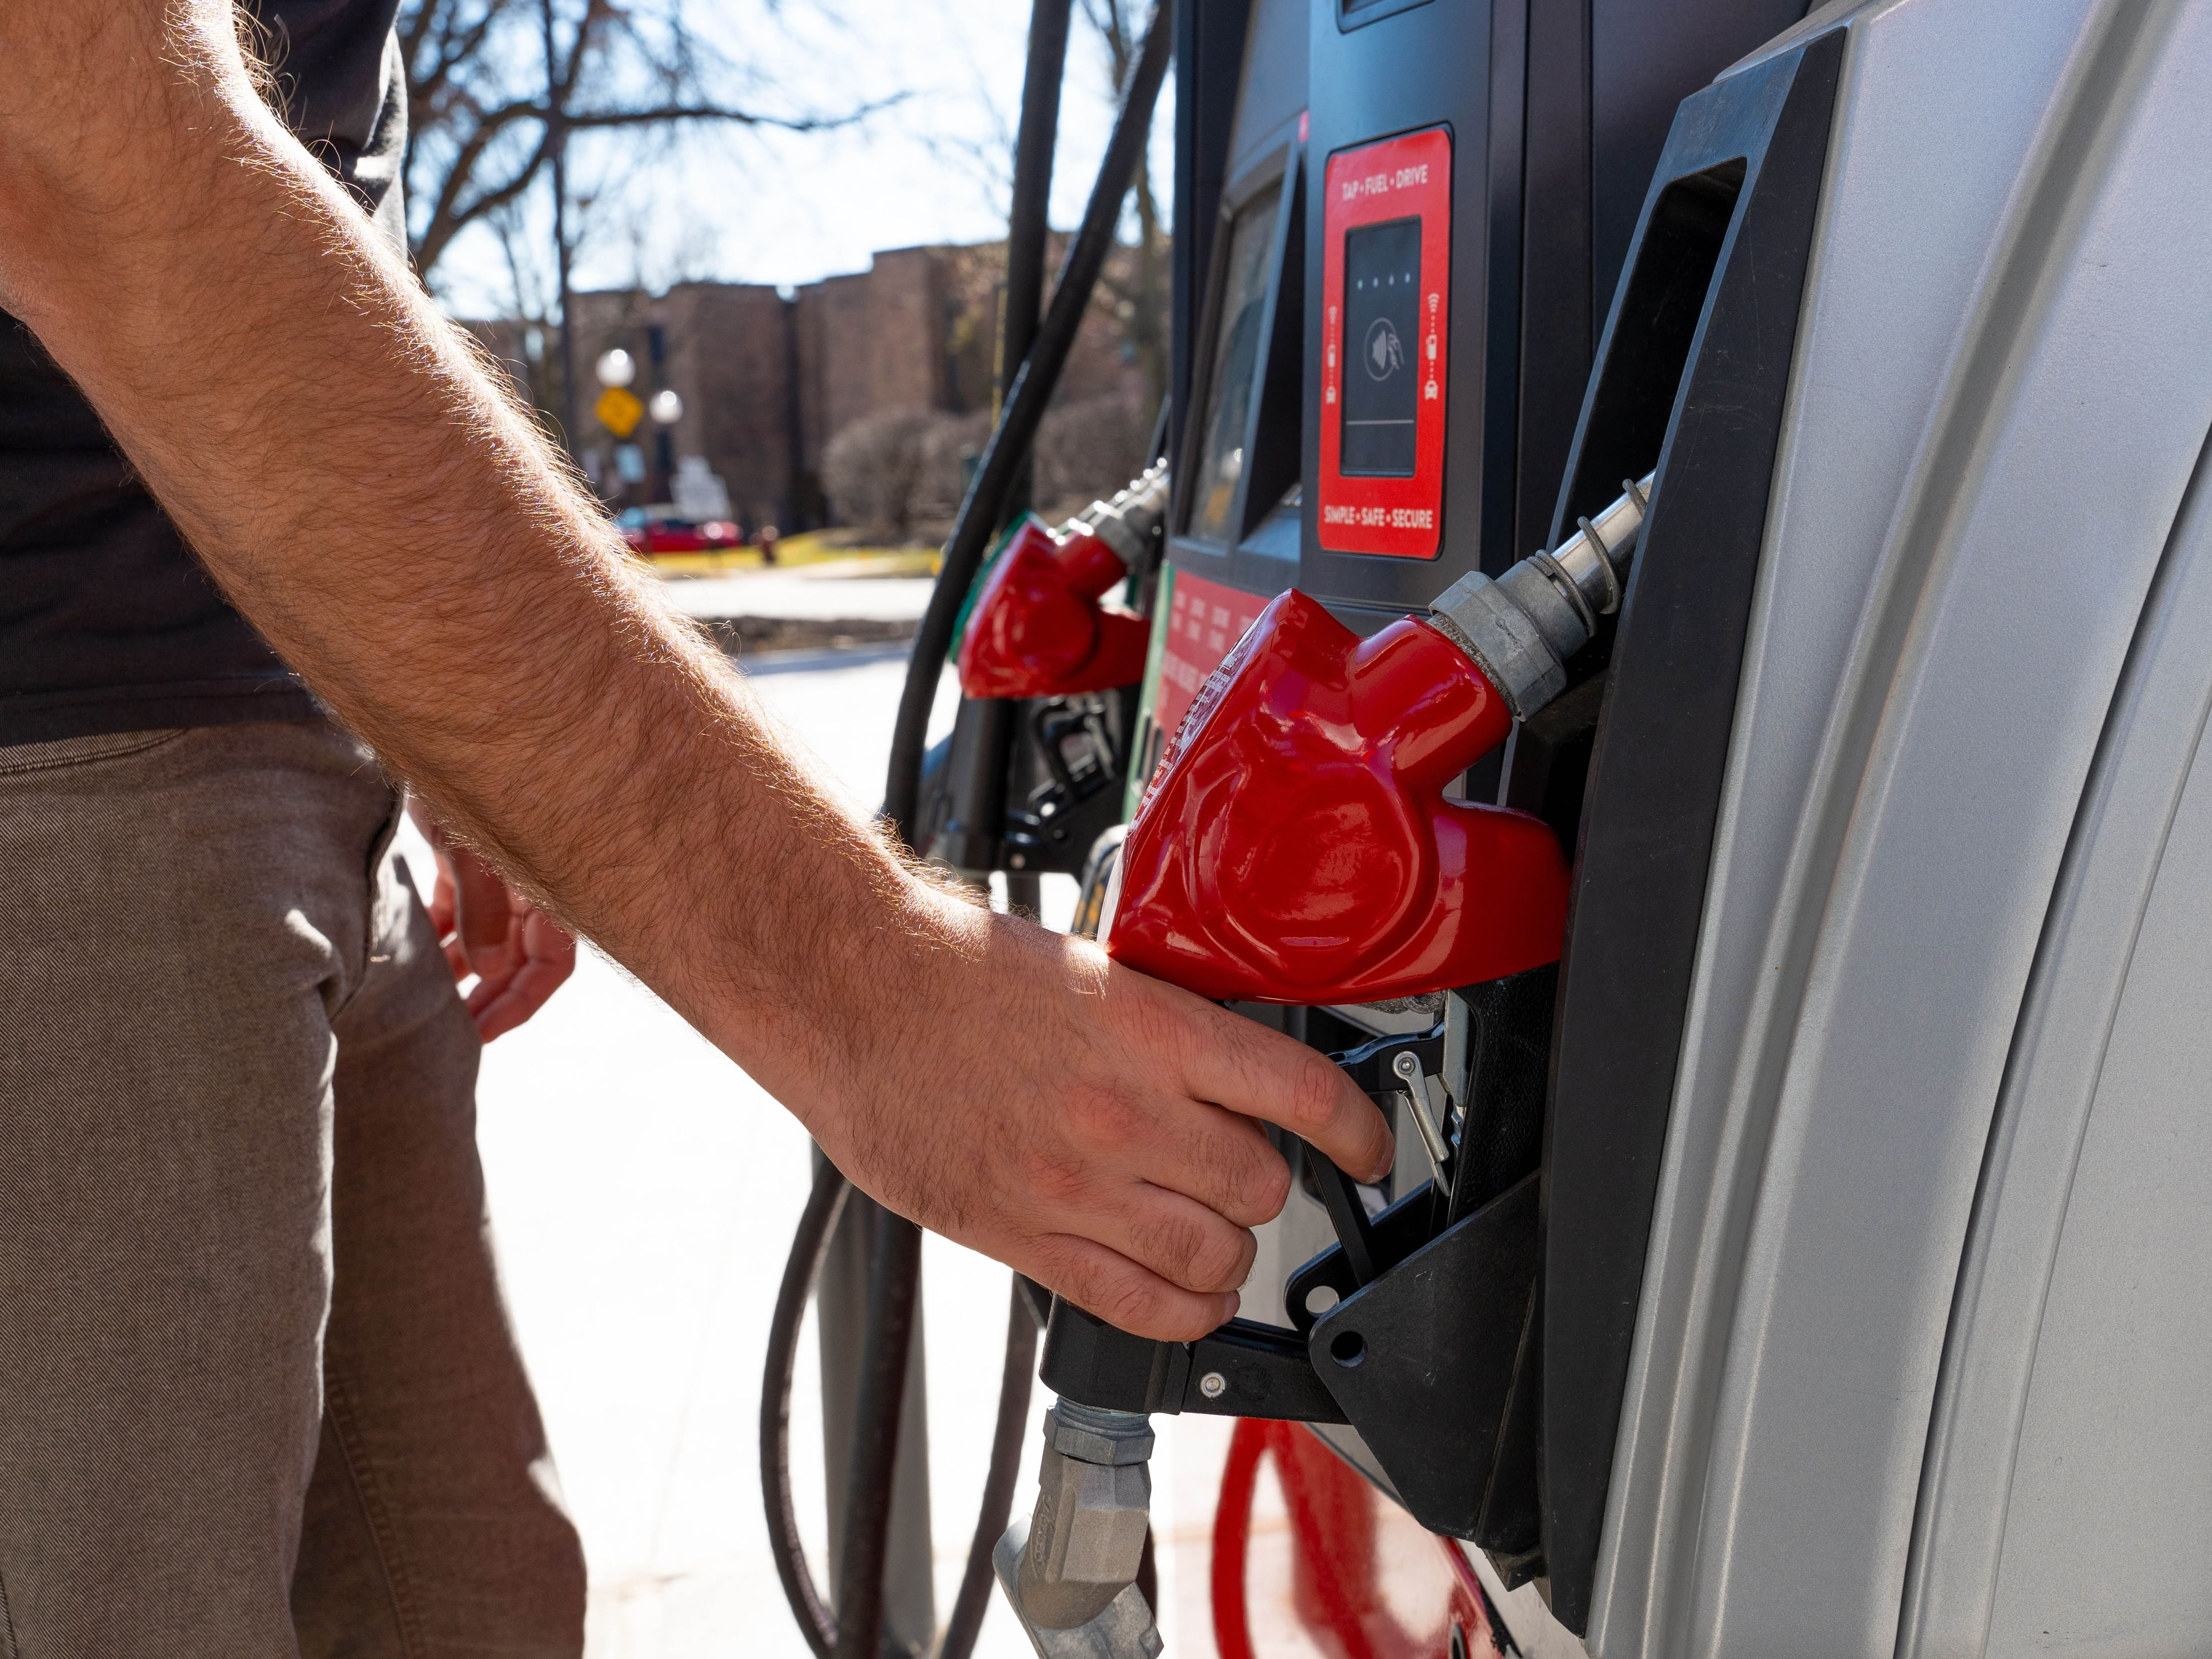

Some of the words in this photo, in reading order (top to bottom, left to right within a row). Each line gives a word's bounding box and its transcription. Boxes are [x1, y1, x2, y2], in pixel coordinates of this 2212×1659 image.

[1342, 180, 1359, 200] TAP
[1364, 174, 1389, 196] FUEL
[1396, 164, 1428, 189] DRIVE
[1324, 505, 1355, 525] SIMPLE
[1361, 507, 1385, 527] SAFE
[1392, 508, 1433, 529] SECURE
